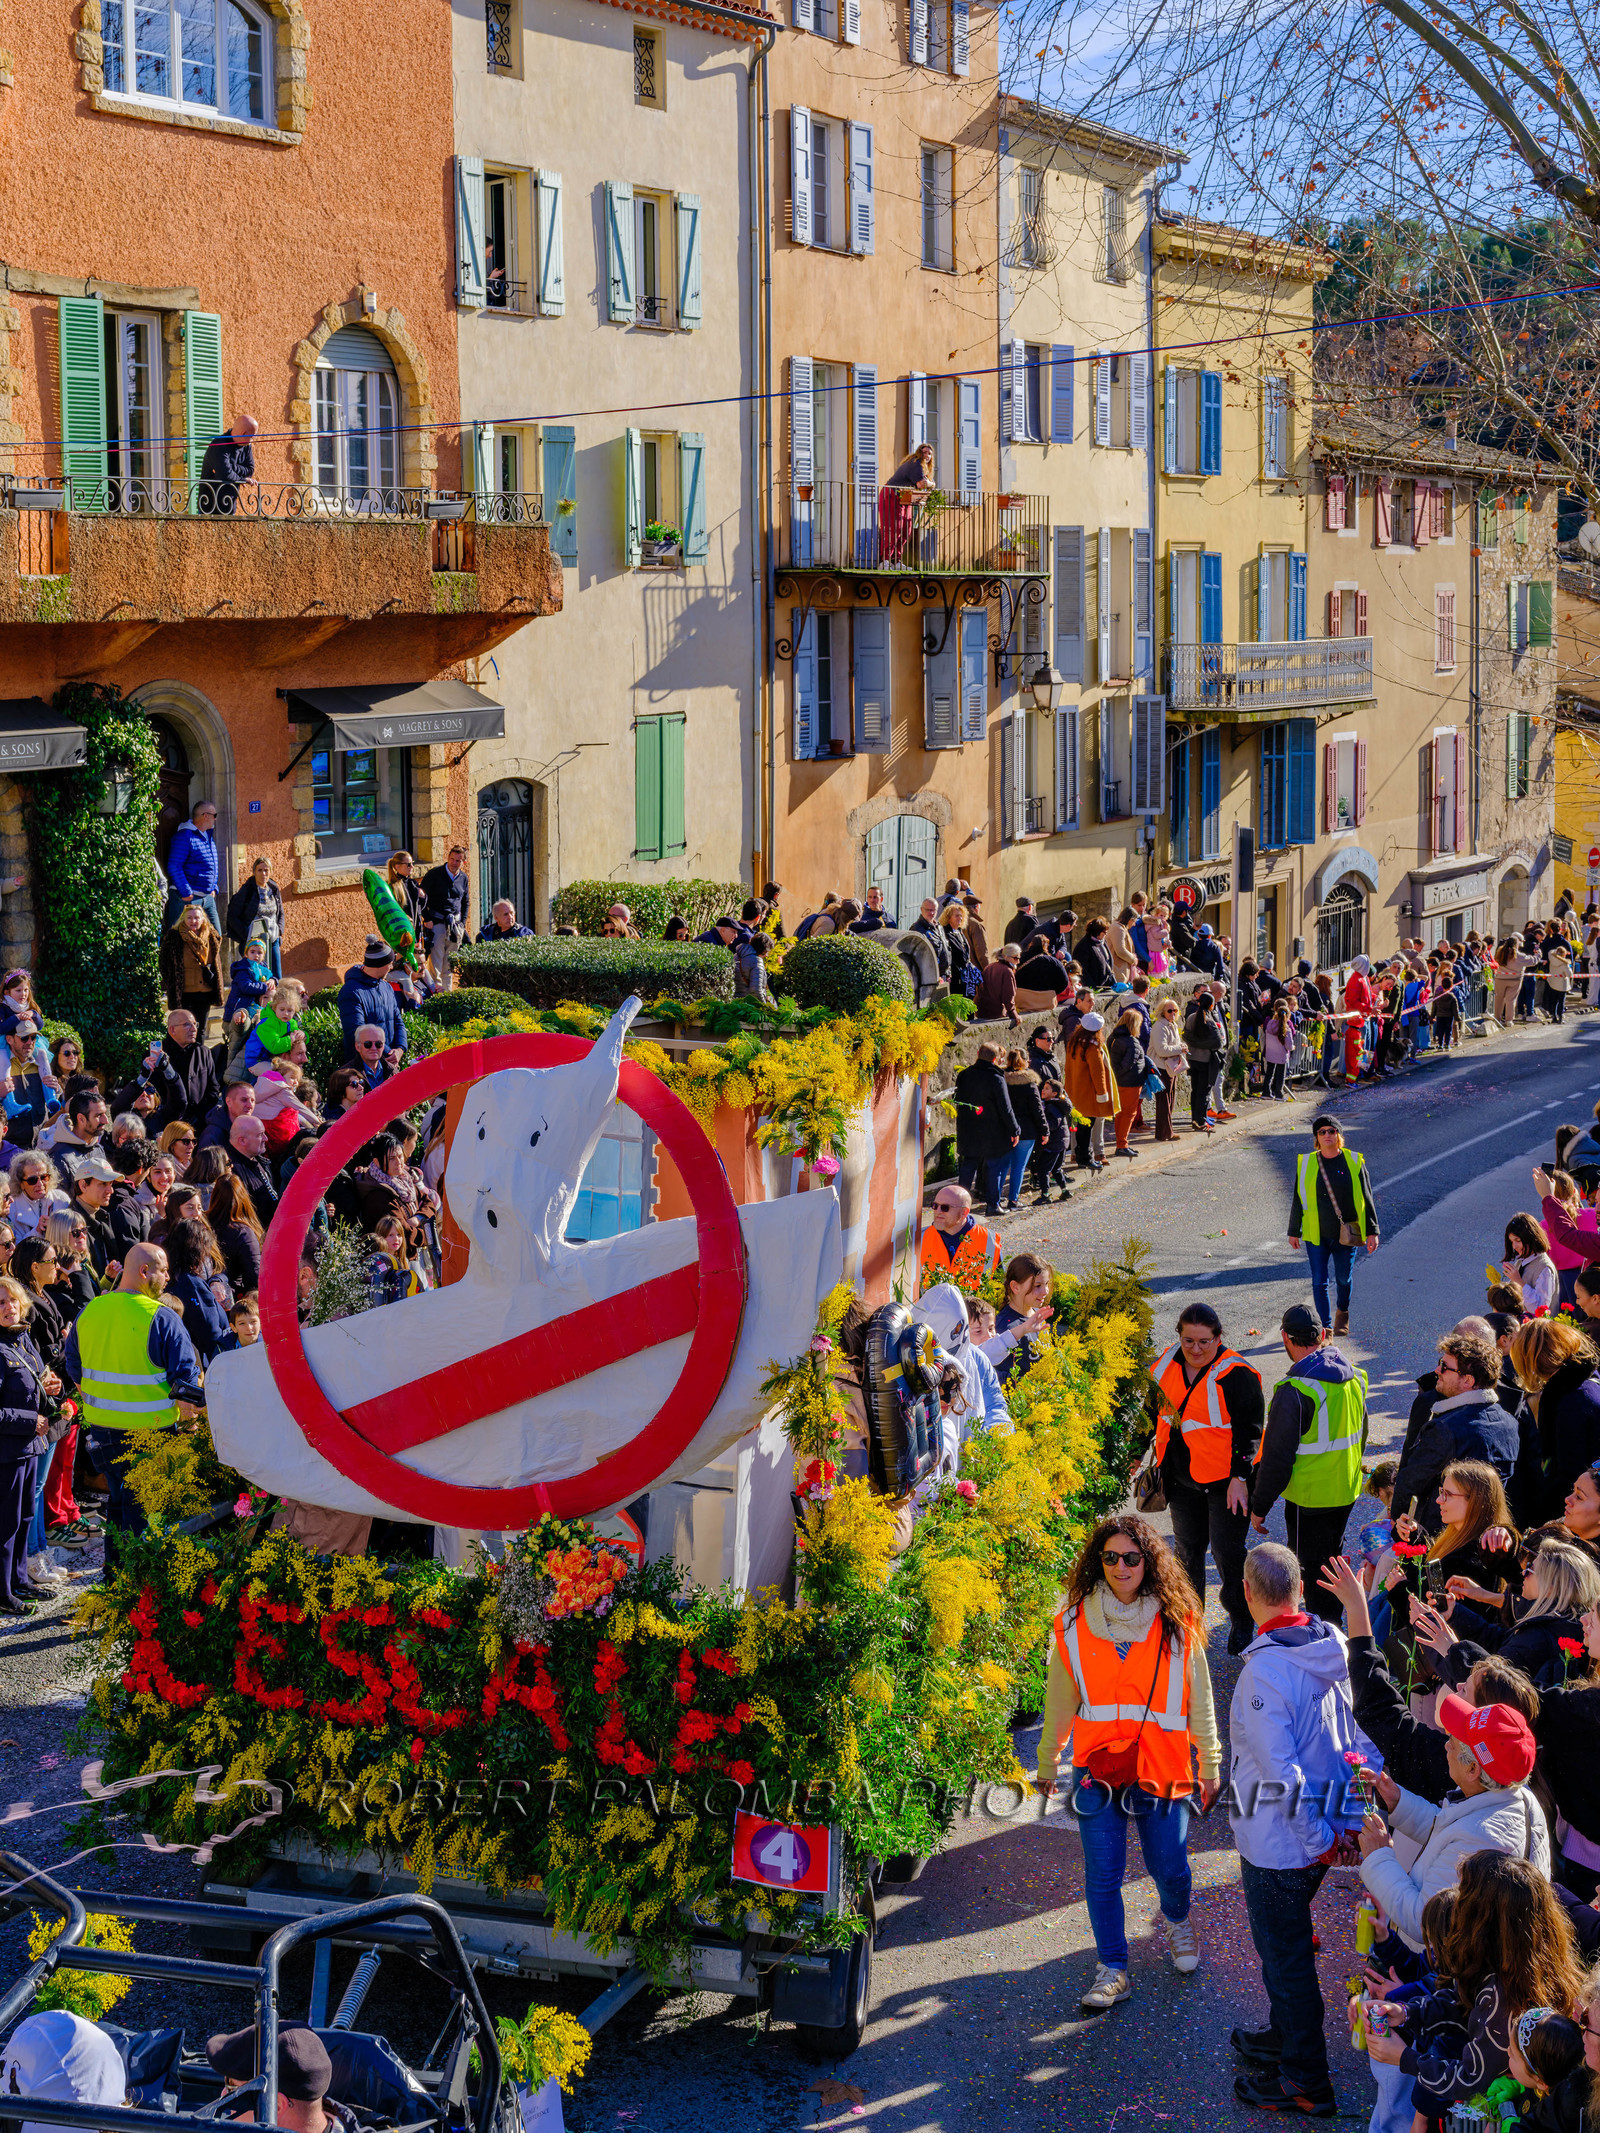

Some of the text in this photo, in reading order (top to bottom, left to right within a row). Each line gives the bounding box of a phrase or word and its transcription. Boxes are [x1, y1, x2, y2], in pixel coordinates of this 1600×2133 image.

[398, 718, 463, 733] MAGREY & SONS
[1, 742, 40, 755] & SONS
[251, 803, 259, 811] 27
[1173, 878, 1197, 890] BARNES
[761, 1831, 798, 1880] 4
